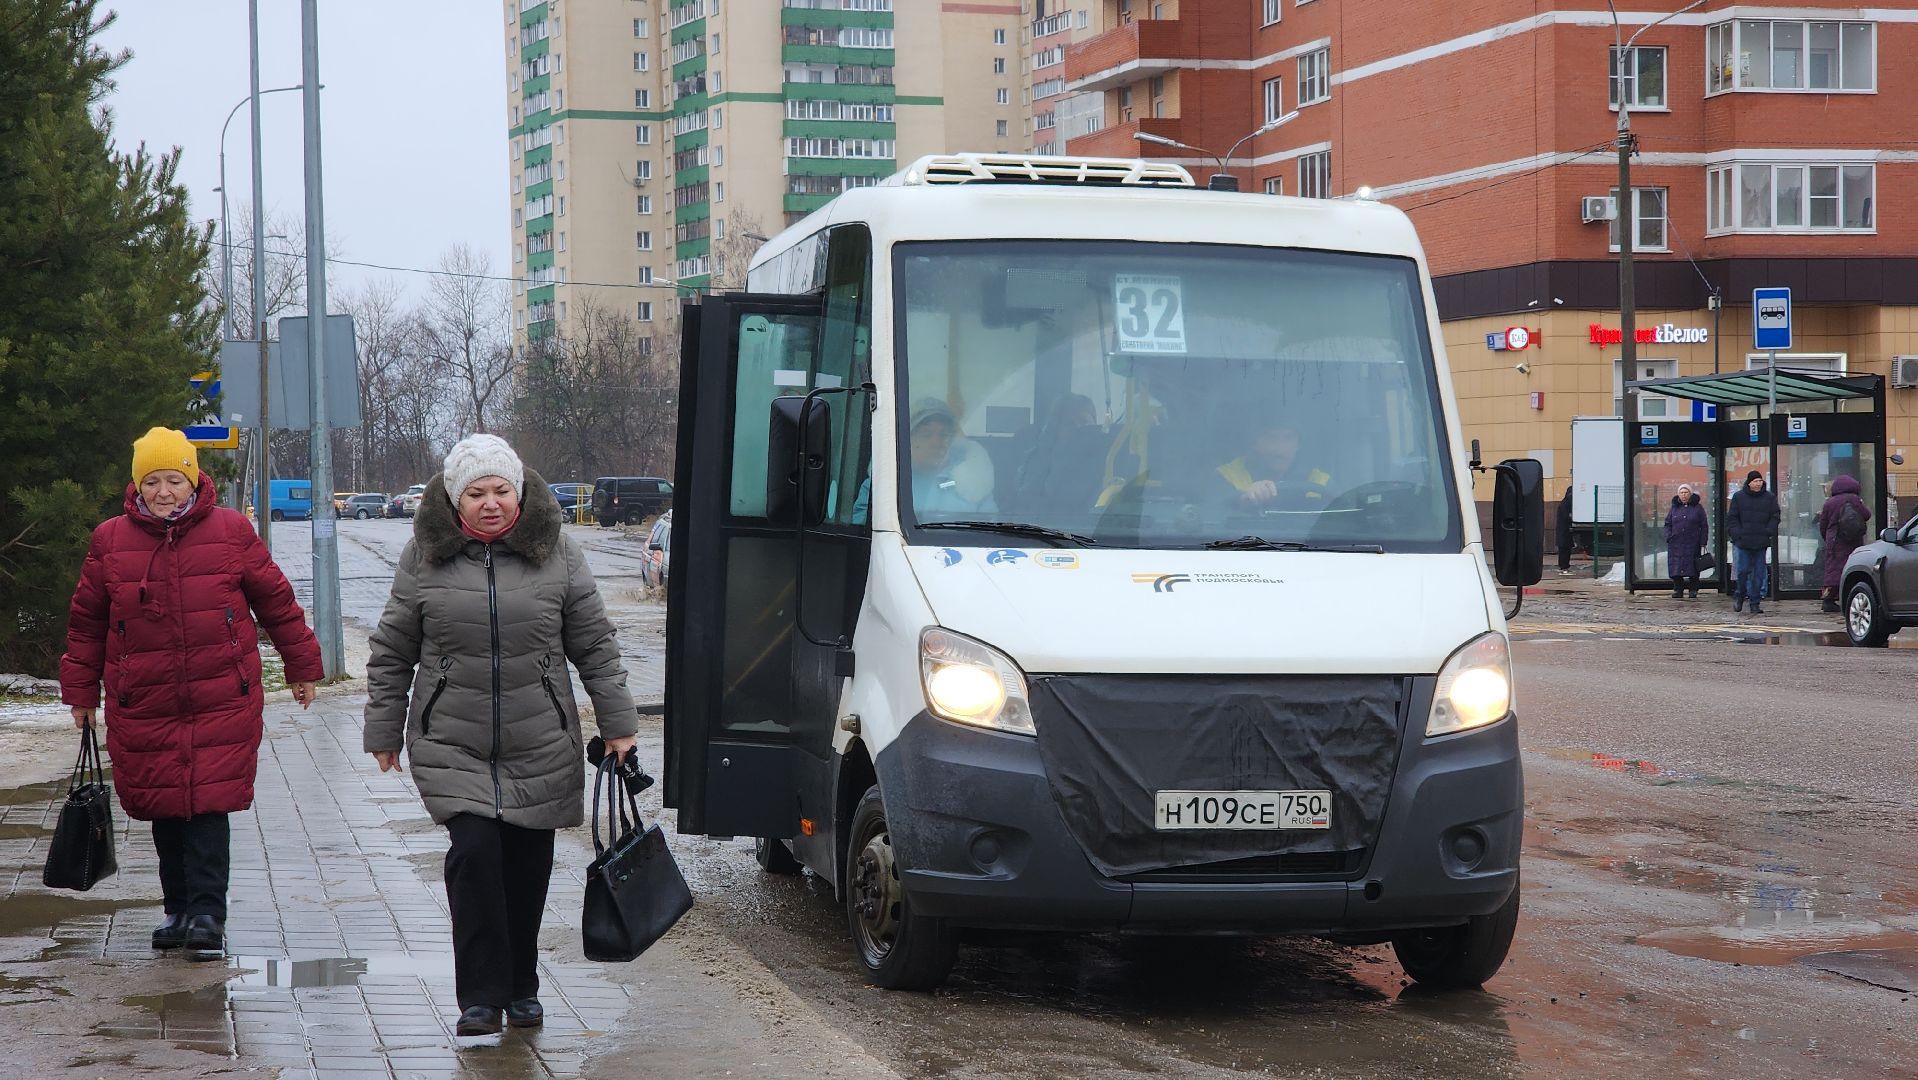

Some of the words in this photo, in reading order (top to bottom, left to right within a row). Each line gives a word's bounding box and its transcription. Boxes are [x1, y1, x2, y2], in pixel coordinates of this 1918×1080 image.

[1119, 287, 1181, 338] 32
[1165, 796, 1275, 825] Н109СЕ
[1282, 795, 1322, 816] 750
[1291, 816, 1312, 825] RUS
